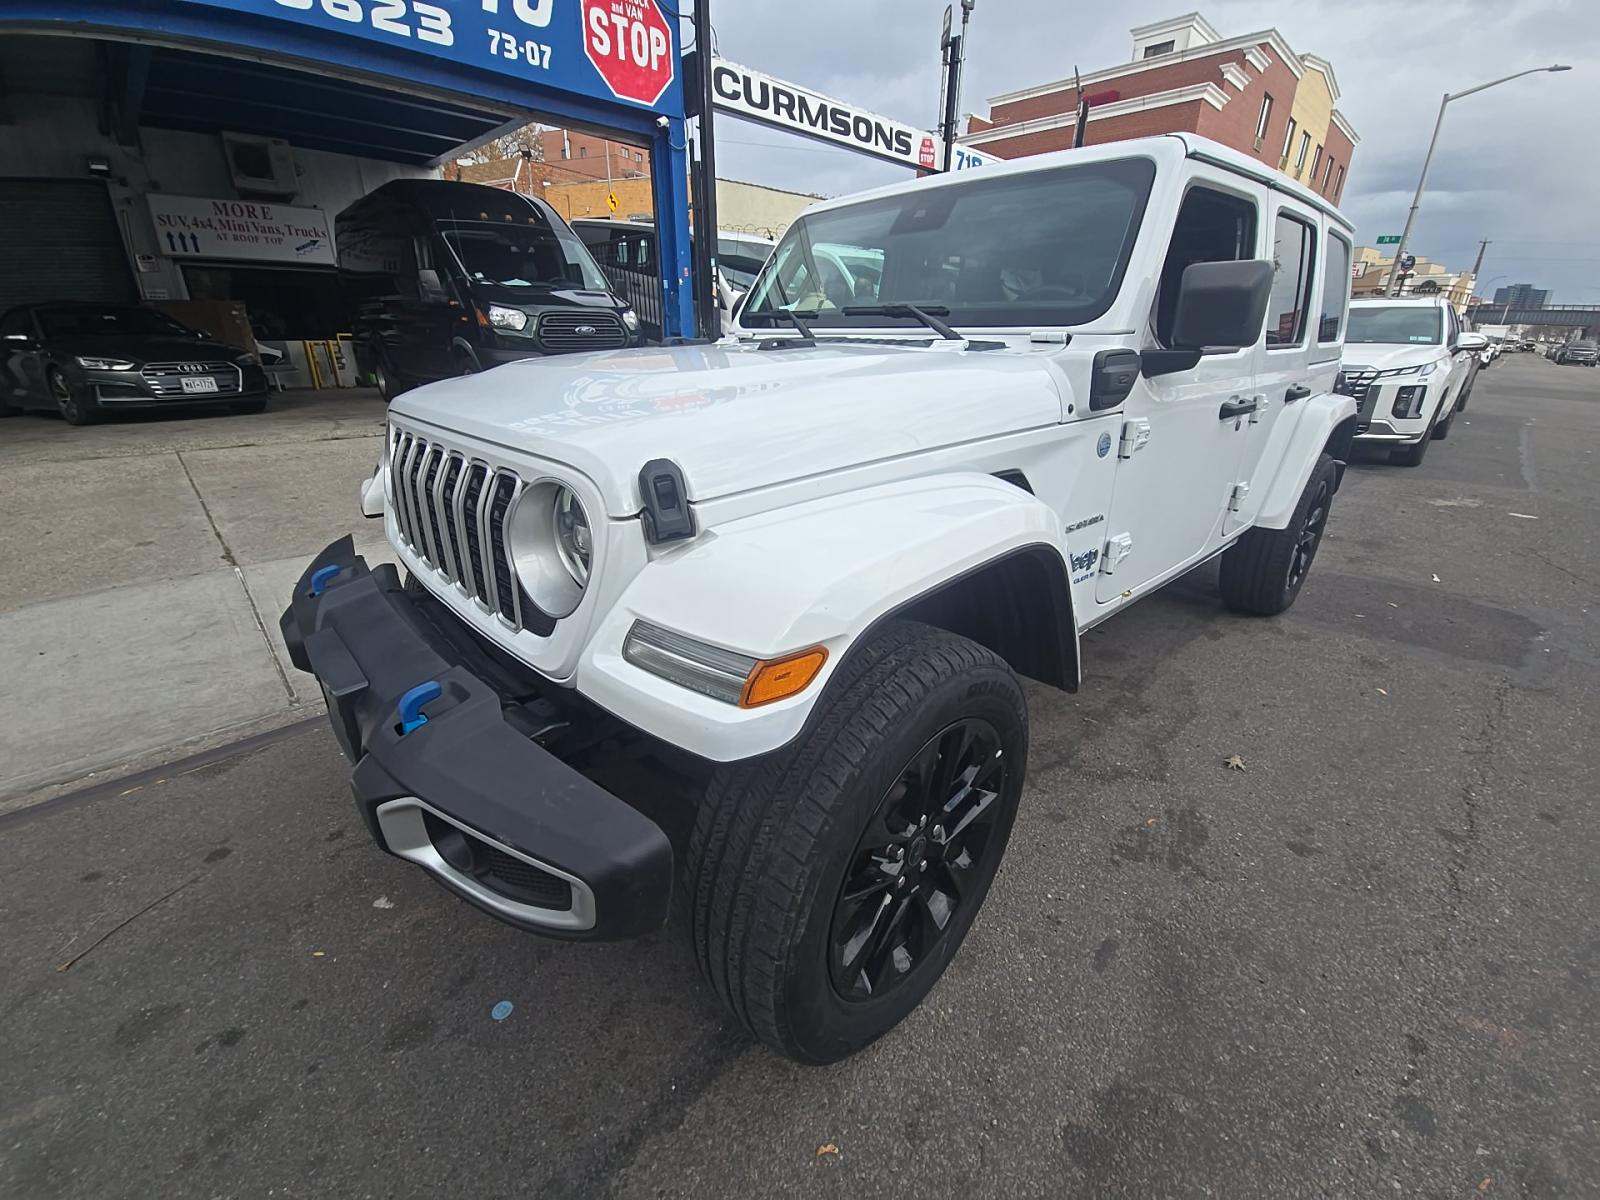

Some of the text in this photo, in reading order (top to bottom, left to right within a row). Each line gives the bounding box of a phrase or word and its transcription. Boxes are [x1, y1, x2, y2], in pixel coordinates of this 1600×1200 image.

[274, 0, 454, 46] 623
[611, 2, 624, 14] and
[625, 3, 643, 21] VAN
[487, 28, 551, 70] 73-07
[589, 7, 666, 71] STOP
[713, 66, 913, 156] CURMSONS
[212, 201, 273, 220] MORE
[264, 236, 284, 246] TOP
